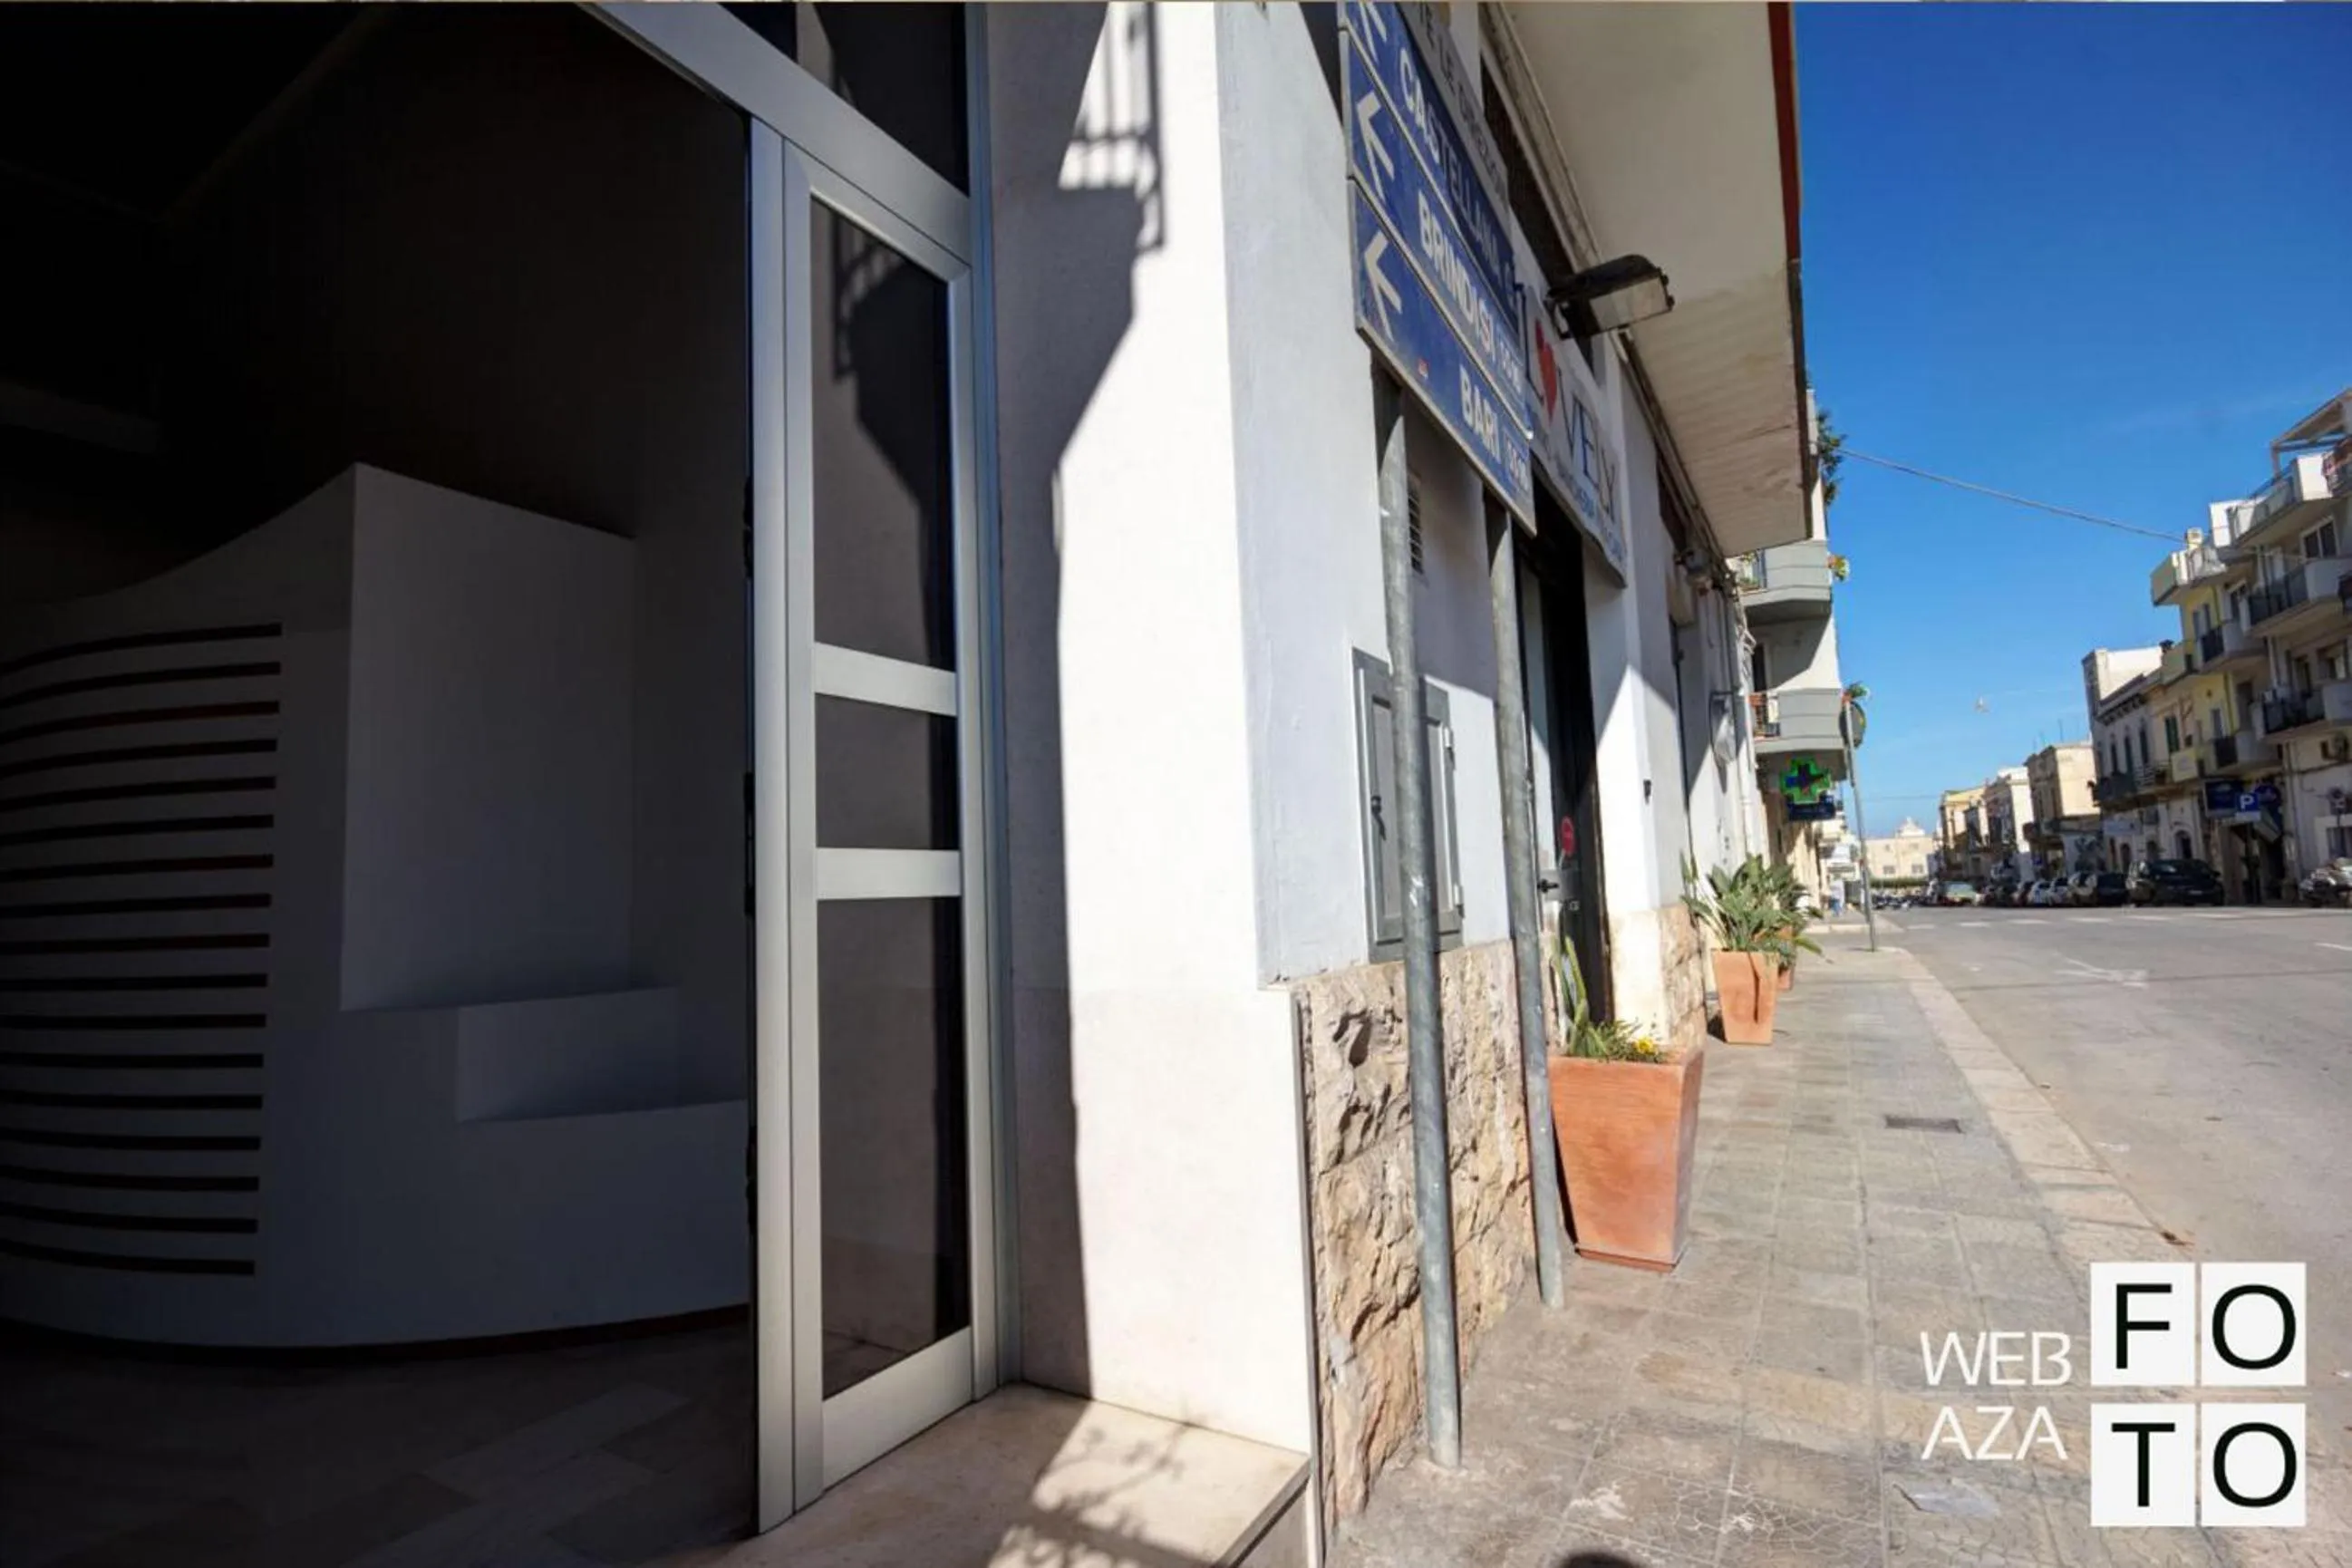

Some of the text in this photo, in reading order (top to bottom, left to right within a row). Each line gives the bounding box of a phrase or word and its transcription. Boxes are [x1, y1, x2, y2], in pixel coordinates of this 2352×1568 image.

[1418, 190, 1496, 363] BRINDISI
[1459, 363, 1501, 465] BARI
[2240, 795, 2254, 809] P
